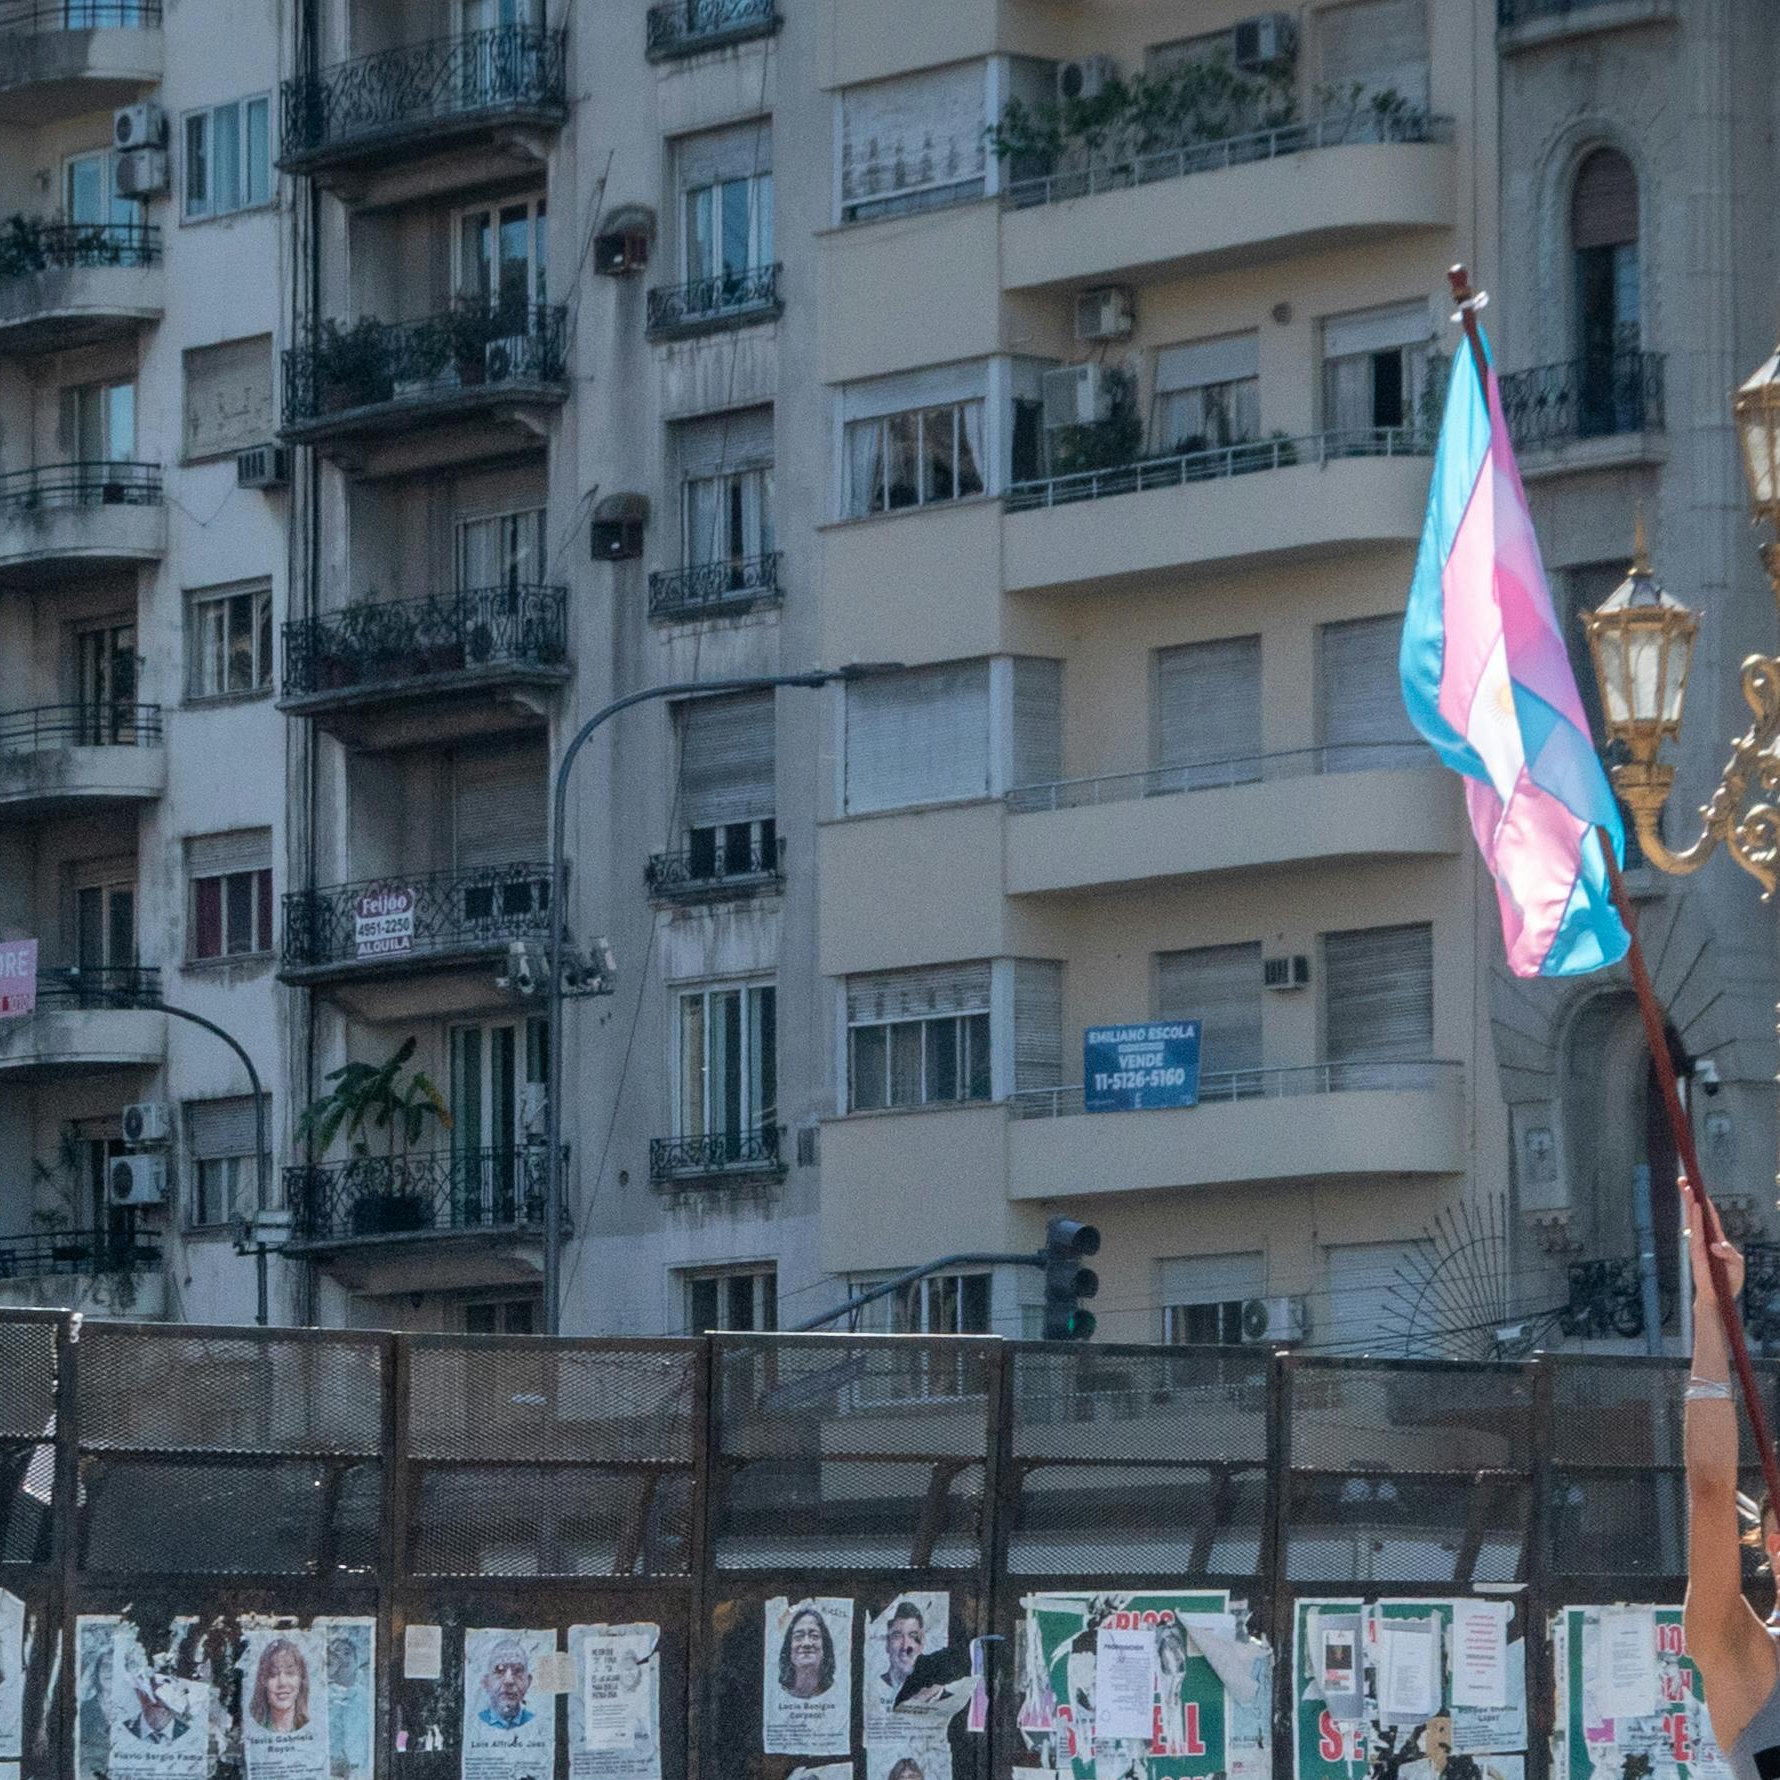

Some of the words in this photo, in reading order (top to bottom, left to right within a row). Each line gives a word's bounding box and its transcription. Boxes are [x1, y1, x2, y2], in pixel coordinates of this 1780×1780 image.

[358, 936, 411, 955] ALQUILA
[1088, 1028, 1145, 1045] EMILIANO
[1148, 1025, 1195, 1040] ESCOLA
[1120, 1054, 1164, 1068] VENDE
